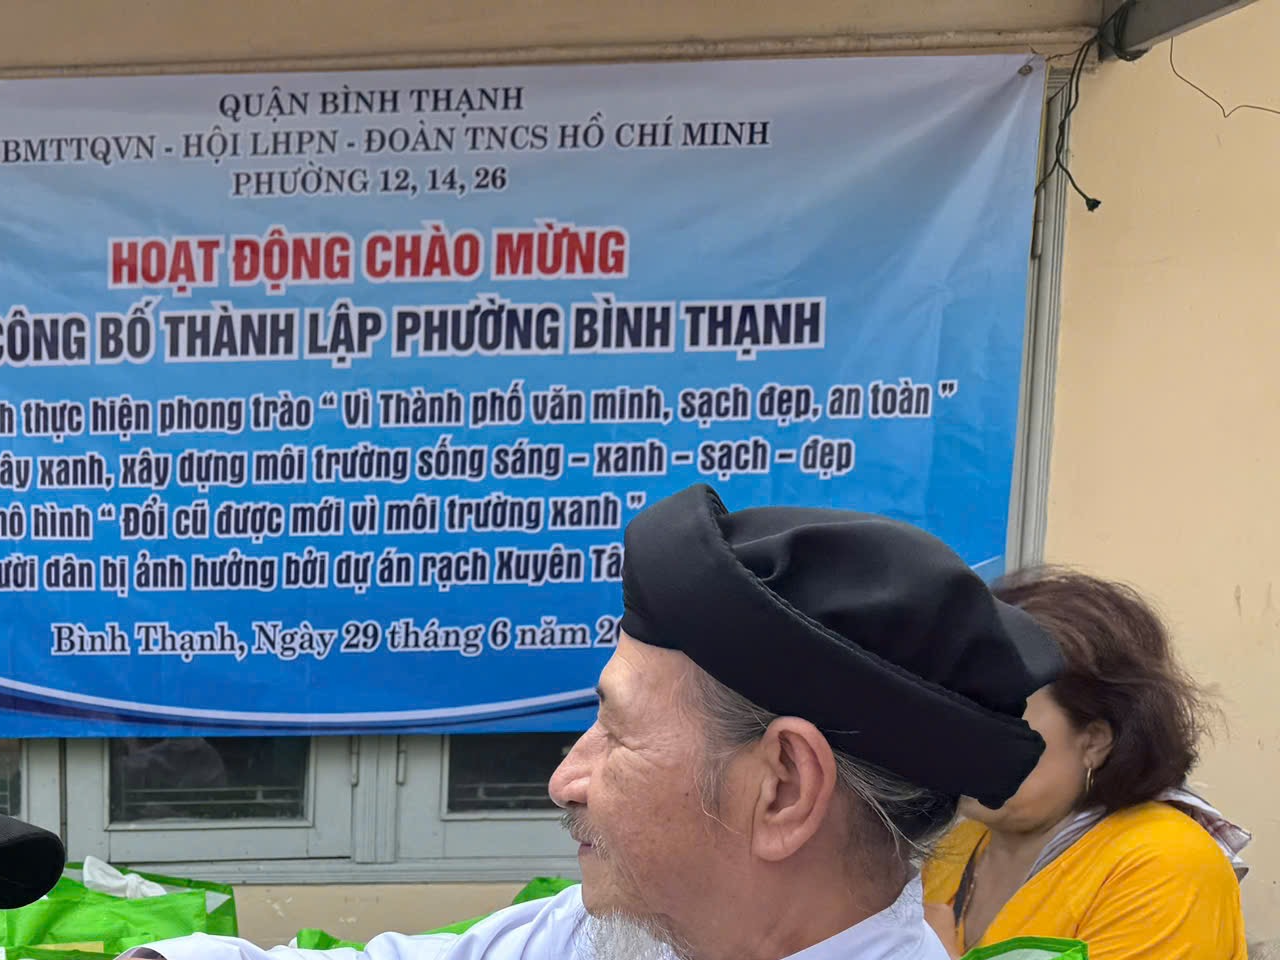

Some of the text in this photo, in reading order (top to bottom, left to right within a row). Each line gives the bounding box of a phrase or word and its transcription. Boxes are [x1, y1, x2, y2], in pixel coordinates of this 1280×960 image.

[218, 84, 524, 123] QUẬN BÌNH THẠNH
[183, 125, 239, 165] HỘI
[251, 129, 338, 156] LHPN
[365, 119, 456, 153] ĐOÀN
[464, 124, 548, 151] TNCS
[558, 111, 605, 149] HỒ
[615, 115, 673, 148] CHÍ
[681, 121, 770, 146] MINH
[234, 161, 507, 196] PHƯỜNG 12, 14, 26
[112, 223, 625, 293] HOẠT ĐỘNG CHÀO MỪNG
[100, 301, 151, 359] BỐ
[164, 305, 294, 357] THÀNH
[308, 303, 382, 363] LẬP
[396, 298, 560, 352] PHƯỜNG
[574, 297, 671, 349] BÌNH
[684, 302, 821, 355] THẠNH
[23, 402, 82, 439] thực
[92, 397, 149, 438] hiện
[160, 399, 242, 433] phong
[252, 394, 311, 428] trào
[345, 392, 369, 425] Vì
[380, 390, 461, 424] Thành
[472, 383, 522, 425] phố
[533, 388, 581, 421] văn
[593, 388, 670, 420] minh,
[681, 387, 748, 425] sạch
[759, 386, 819, 423] đẹp,
[829, 388, 860, 415] an
[871, 381, 929, 415] toàn
[40, 455, 112, 486] xanh,
[122, 451, 169, 486] xây
[179, 452, 245, 489] dựng
[255, 447, 304, 481] môi
[315, 445, 408, 480] trường
[418, 438, 484, 478] sống
[494, 442, 561, 477] sáng
[596, 442, 663, 473] xanh
[700, 440, 767, 477] sạch
[803, 439, 852, 476] đẹp
[34, 505, 90, 537] hình
[122, 497, 165, 537] Đổi
[175, 503, 206, 536] cũ
[217, 504, 282, 540] được
[292, 499, 341, 533] mới
[352, 498, 376, 531] vì
[387, 497, 436, 530] môi
[447, 495, 541, 530] trường
[551, 496, 618, 526] xanh
[46, 556, 92, 588] dân
[103, 559, 126, 594] bị
[136, 553, 184, 588] ảnh
[194, 551, 275, 588] hưởng
[285, 549, 325, 585] bởi
[336, 554, 371, 591] dự
[379, 551, 411, 583] án
[422, 551, 487, 588] rạch
[497, 546, 581, 583] Xuyên
[592, 545, 621, 578] Tâ
[55, 625, 126, 652] Bình
[137, 625, 245, 659] Thạnh,
[256, 624, 334, 656] Ngày
[344, 623, 379, 649] 29
[389, 621, 482, 652] tháng
[491, 621, 508, 646] 6
[519, 620, 587, 646] năm
